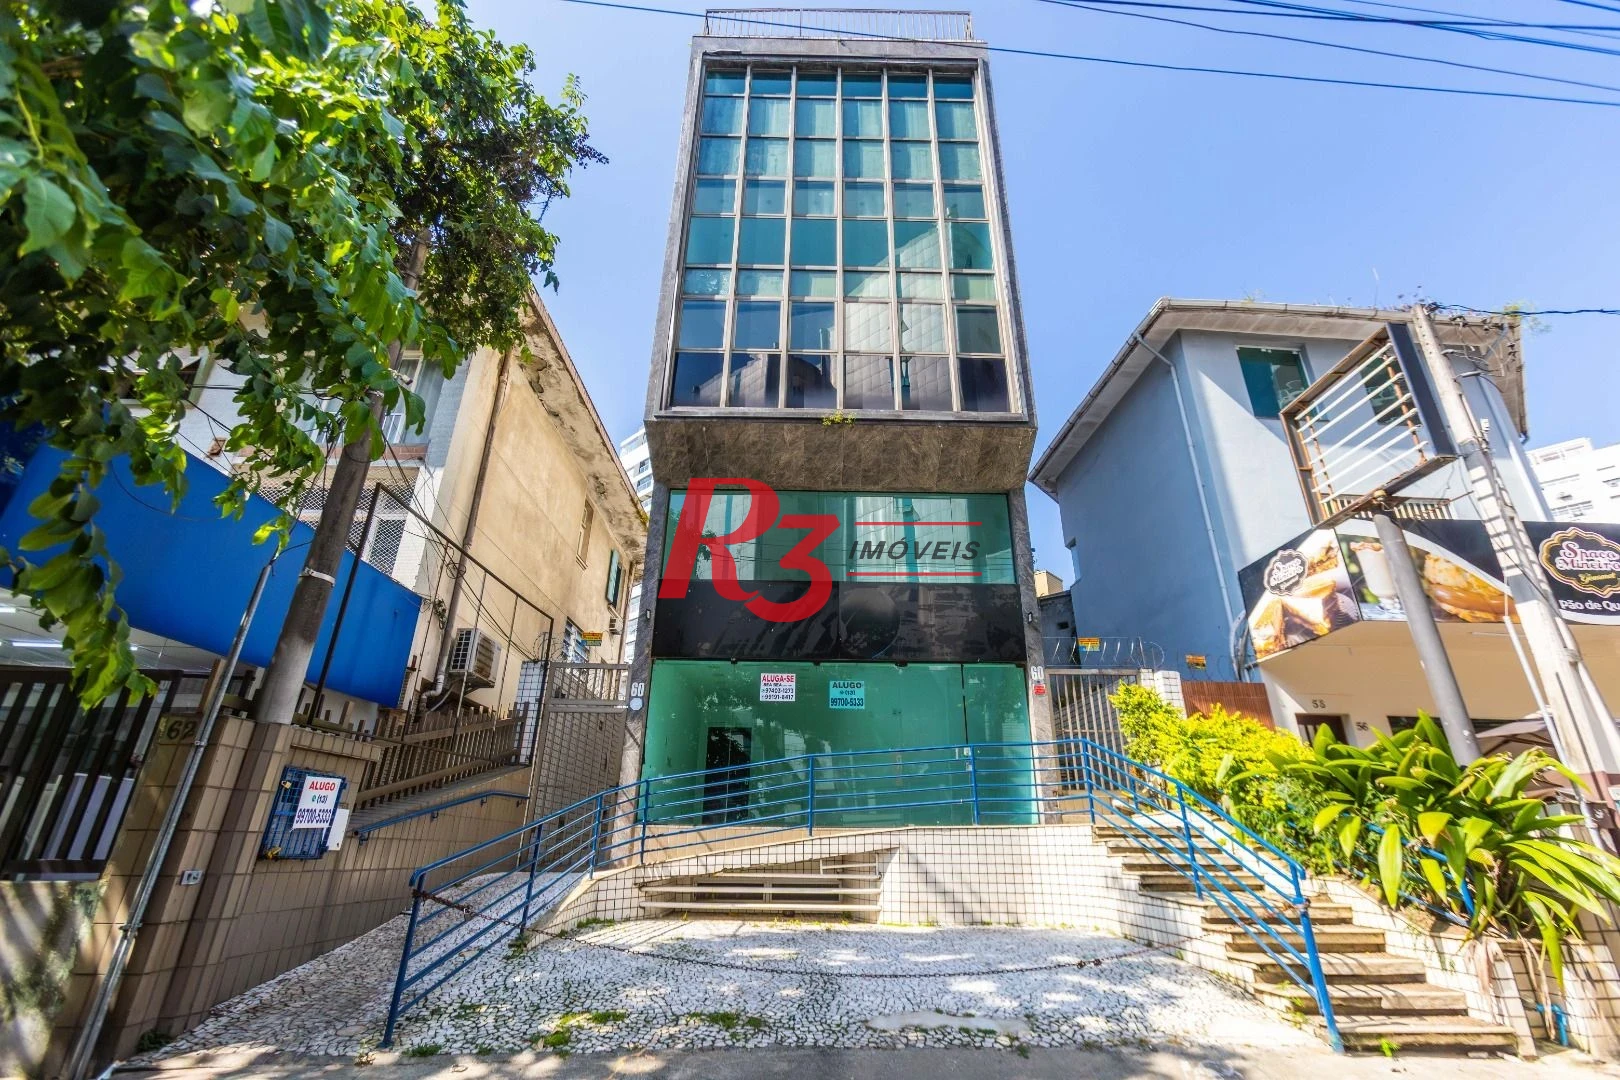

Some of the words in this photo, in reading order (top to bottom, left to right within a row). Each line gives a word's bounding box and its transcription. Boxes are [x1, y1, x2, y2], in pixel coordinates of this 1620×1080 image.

[1559, 600, 1584, 609] Pão
[1585, 600, 1602, 609] de
[1031, 666, 1044, 680] 60
[631, 682, 644, 697] 60
[166, 720, 197, 739] 62
[309, 780, 336, 791] ALUGO
